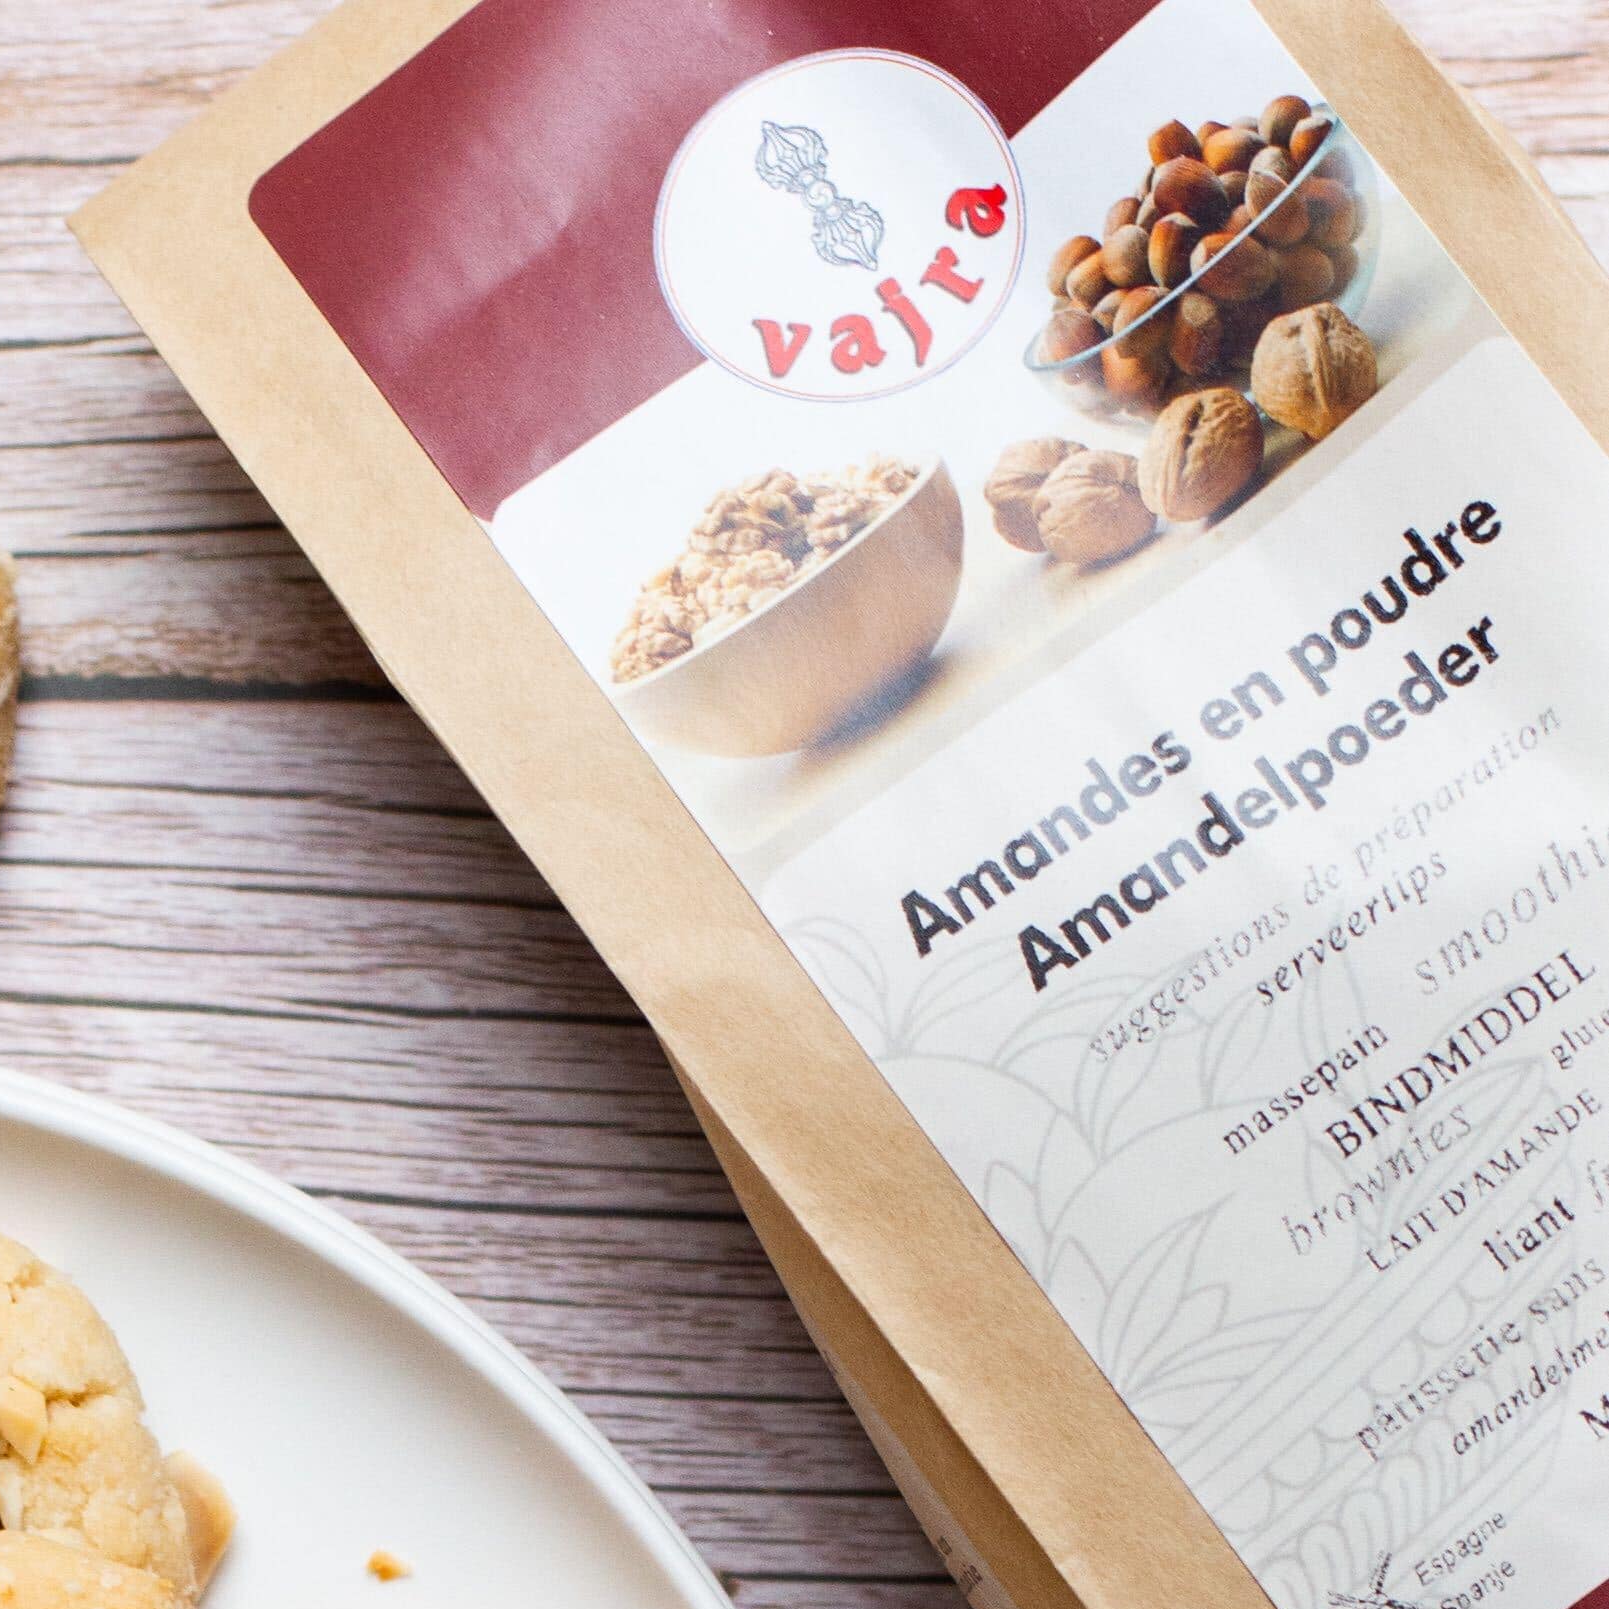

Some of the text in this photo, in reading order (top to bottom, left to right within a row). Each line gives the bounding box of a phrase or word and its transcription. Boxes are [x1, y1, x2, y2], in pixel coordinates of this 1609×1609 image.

[752, 183, 1008, 379] vajra
[902, 497, 1503, 958] Amandes en poudre
[1016, 615, 1501, 993] Amandelpoeder
[1089, 706, 1562, 1064] suggestions de préparation
[1256, 852, 1447, 1007] serveertips
[1415, 825, 1609, 995] smoothi
[1223, 1024, 1389, 1155] massepain
[1324, 949, 1595, 1158] BINDMIDDEL
[1281, 1103, 1472, 1256] brownies
[1365, 1089, 1602, 1272] LAIT D'AMANDE
[1483, 1195, 1576, 1272] liant
[1528, 1258, 1606, 1325] sans
[1452, 1310, 1609, 1458] amandelme
[1414, 1511, 1508, 1587] Espagne
